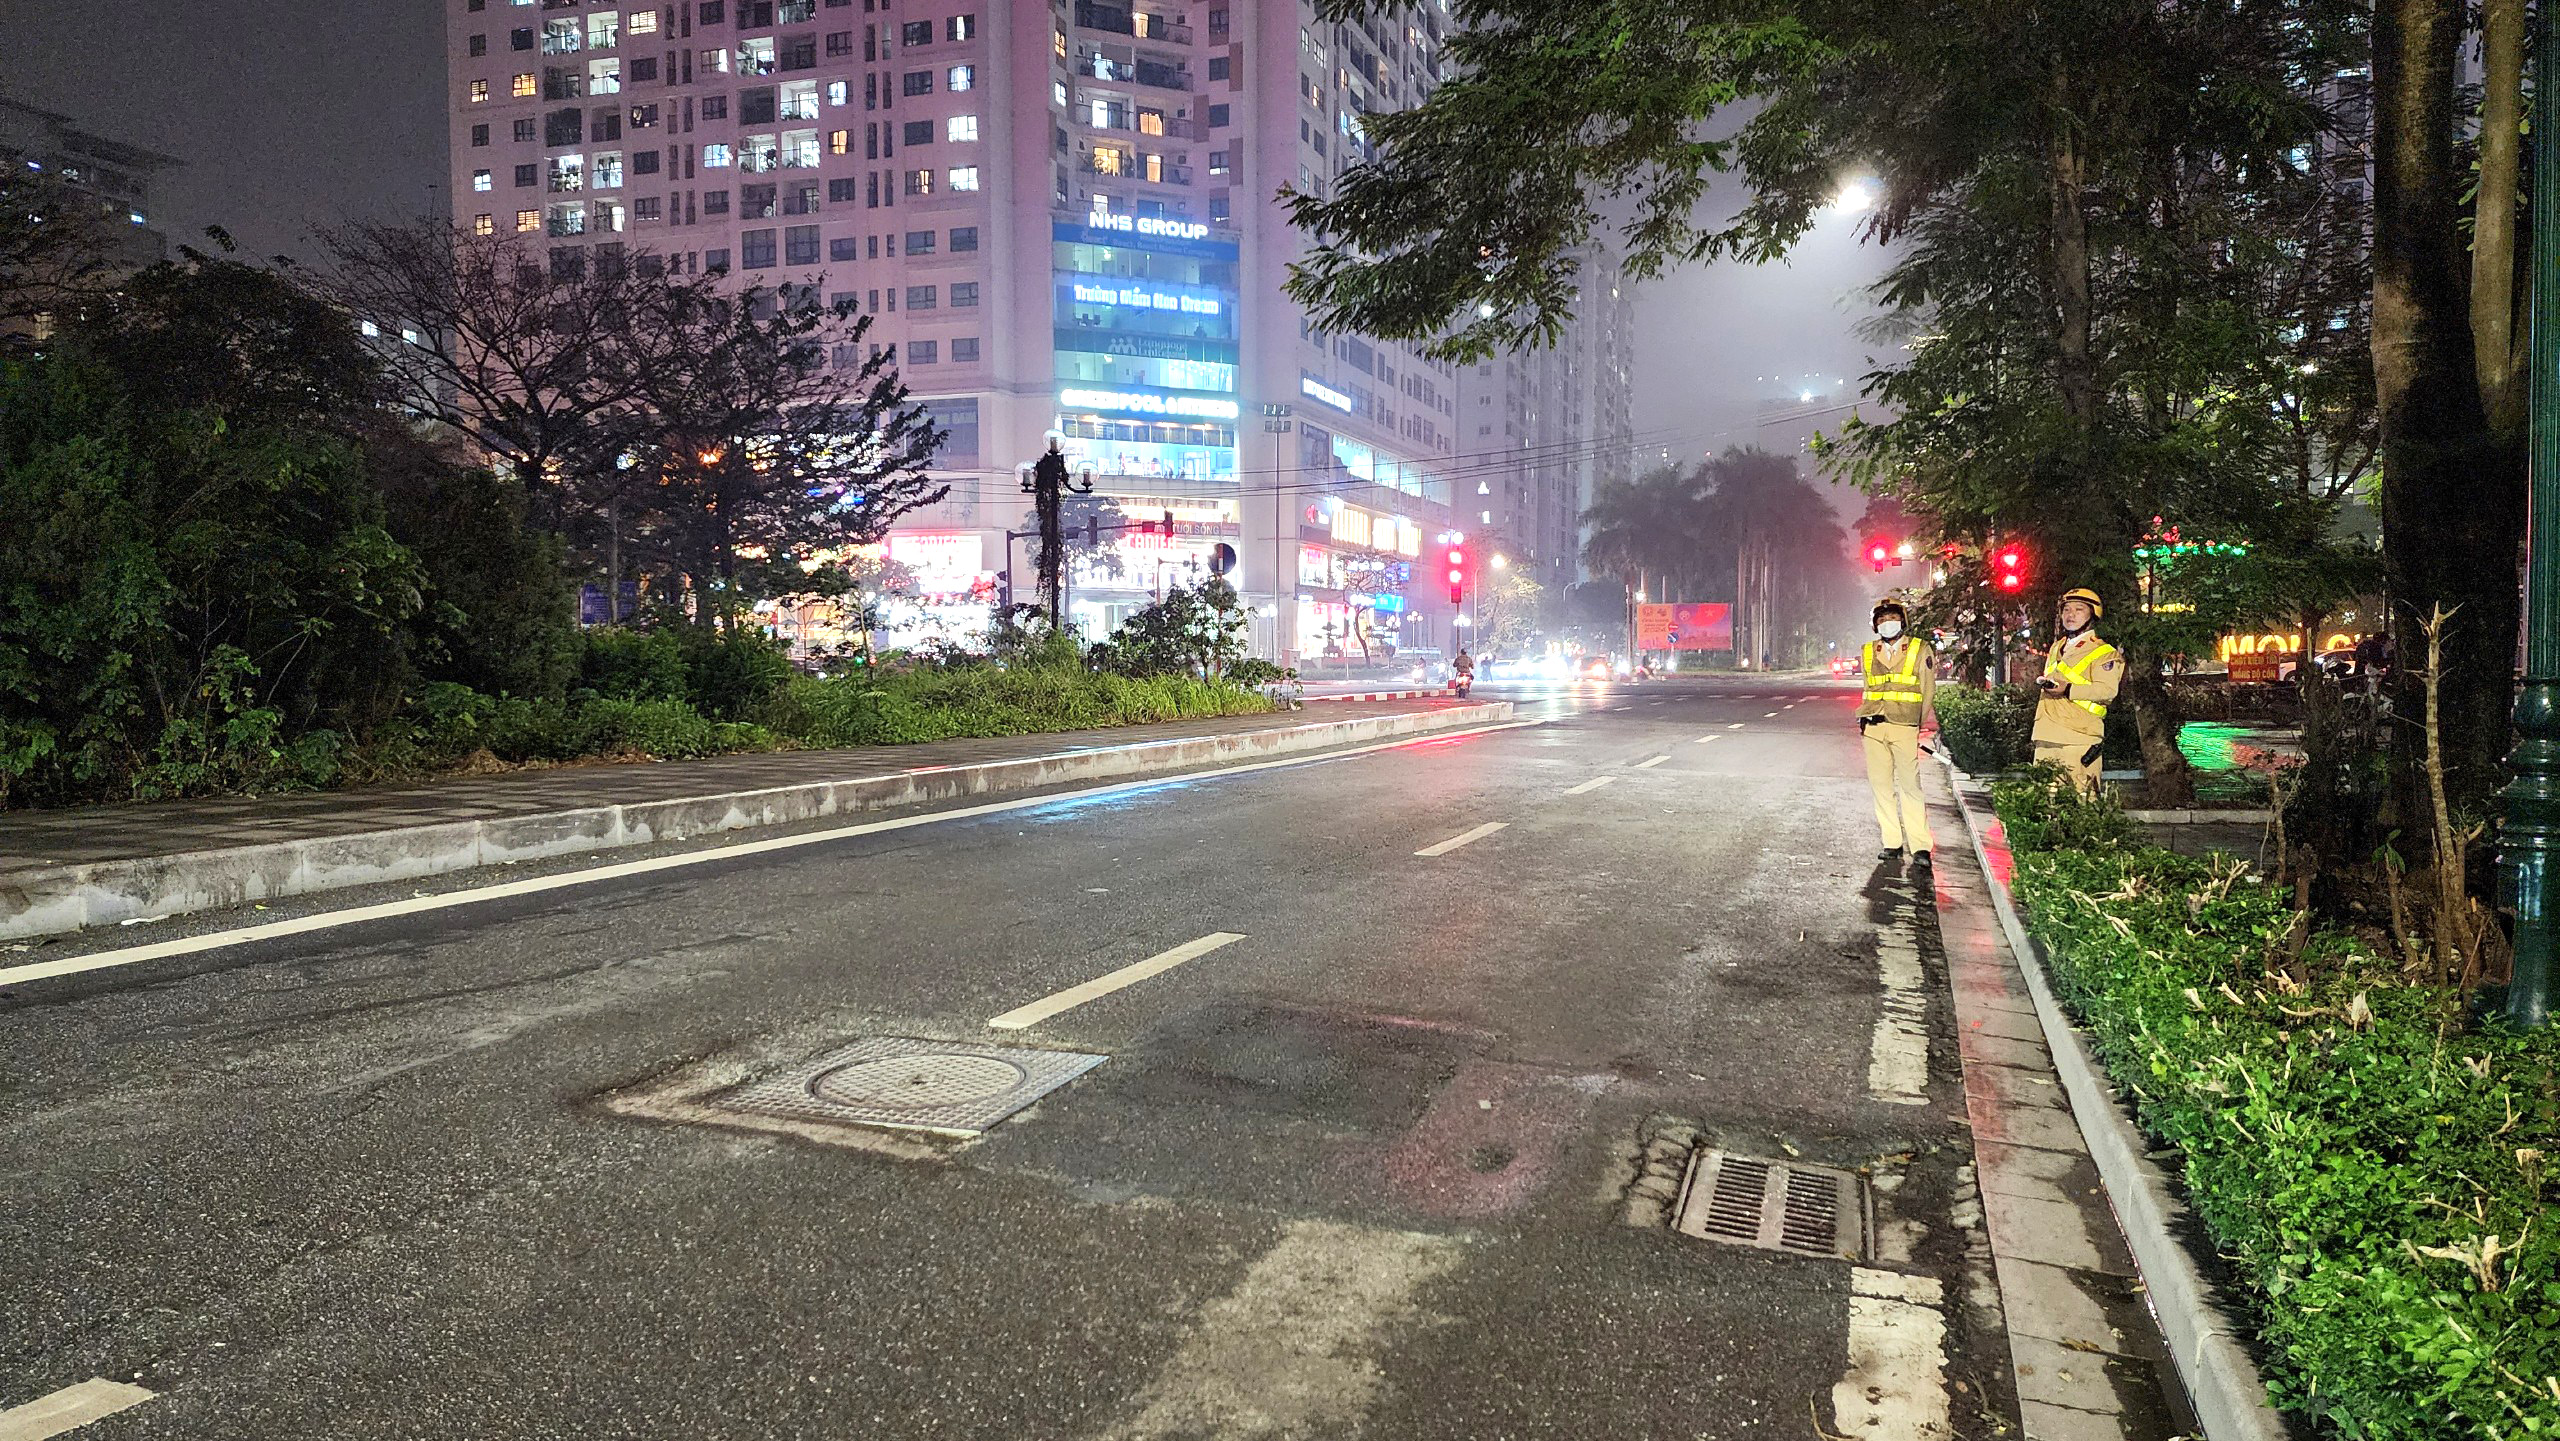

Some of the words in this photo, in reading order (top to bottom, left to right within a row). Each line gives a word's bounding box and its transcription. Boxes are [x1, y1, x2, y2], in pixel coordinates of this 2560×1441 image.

[1089, 212, 1132, 232] NHS
[1137, 217, 1208, 240] GROUP
[1153, 293, 1178, 311] Non
[1181, 295, 1219, 315] Dream
[1119, 394, 1165, 414] POOL
